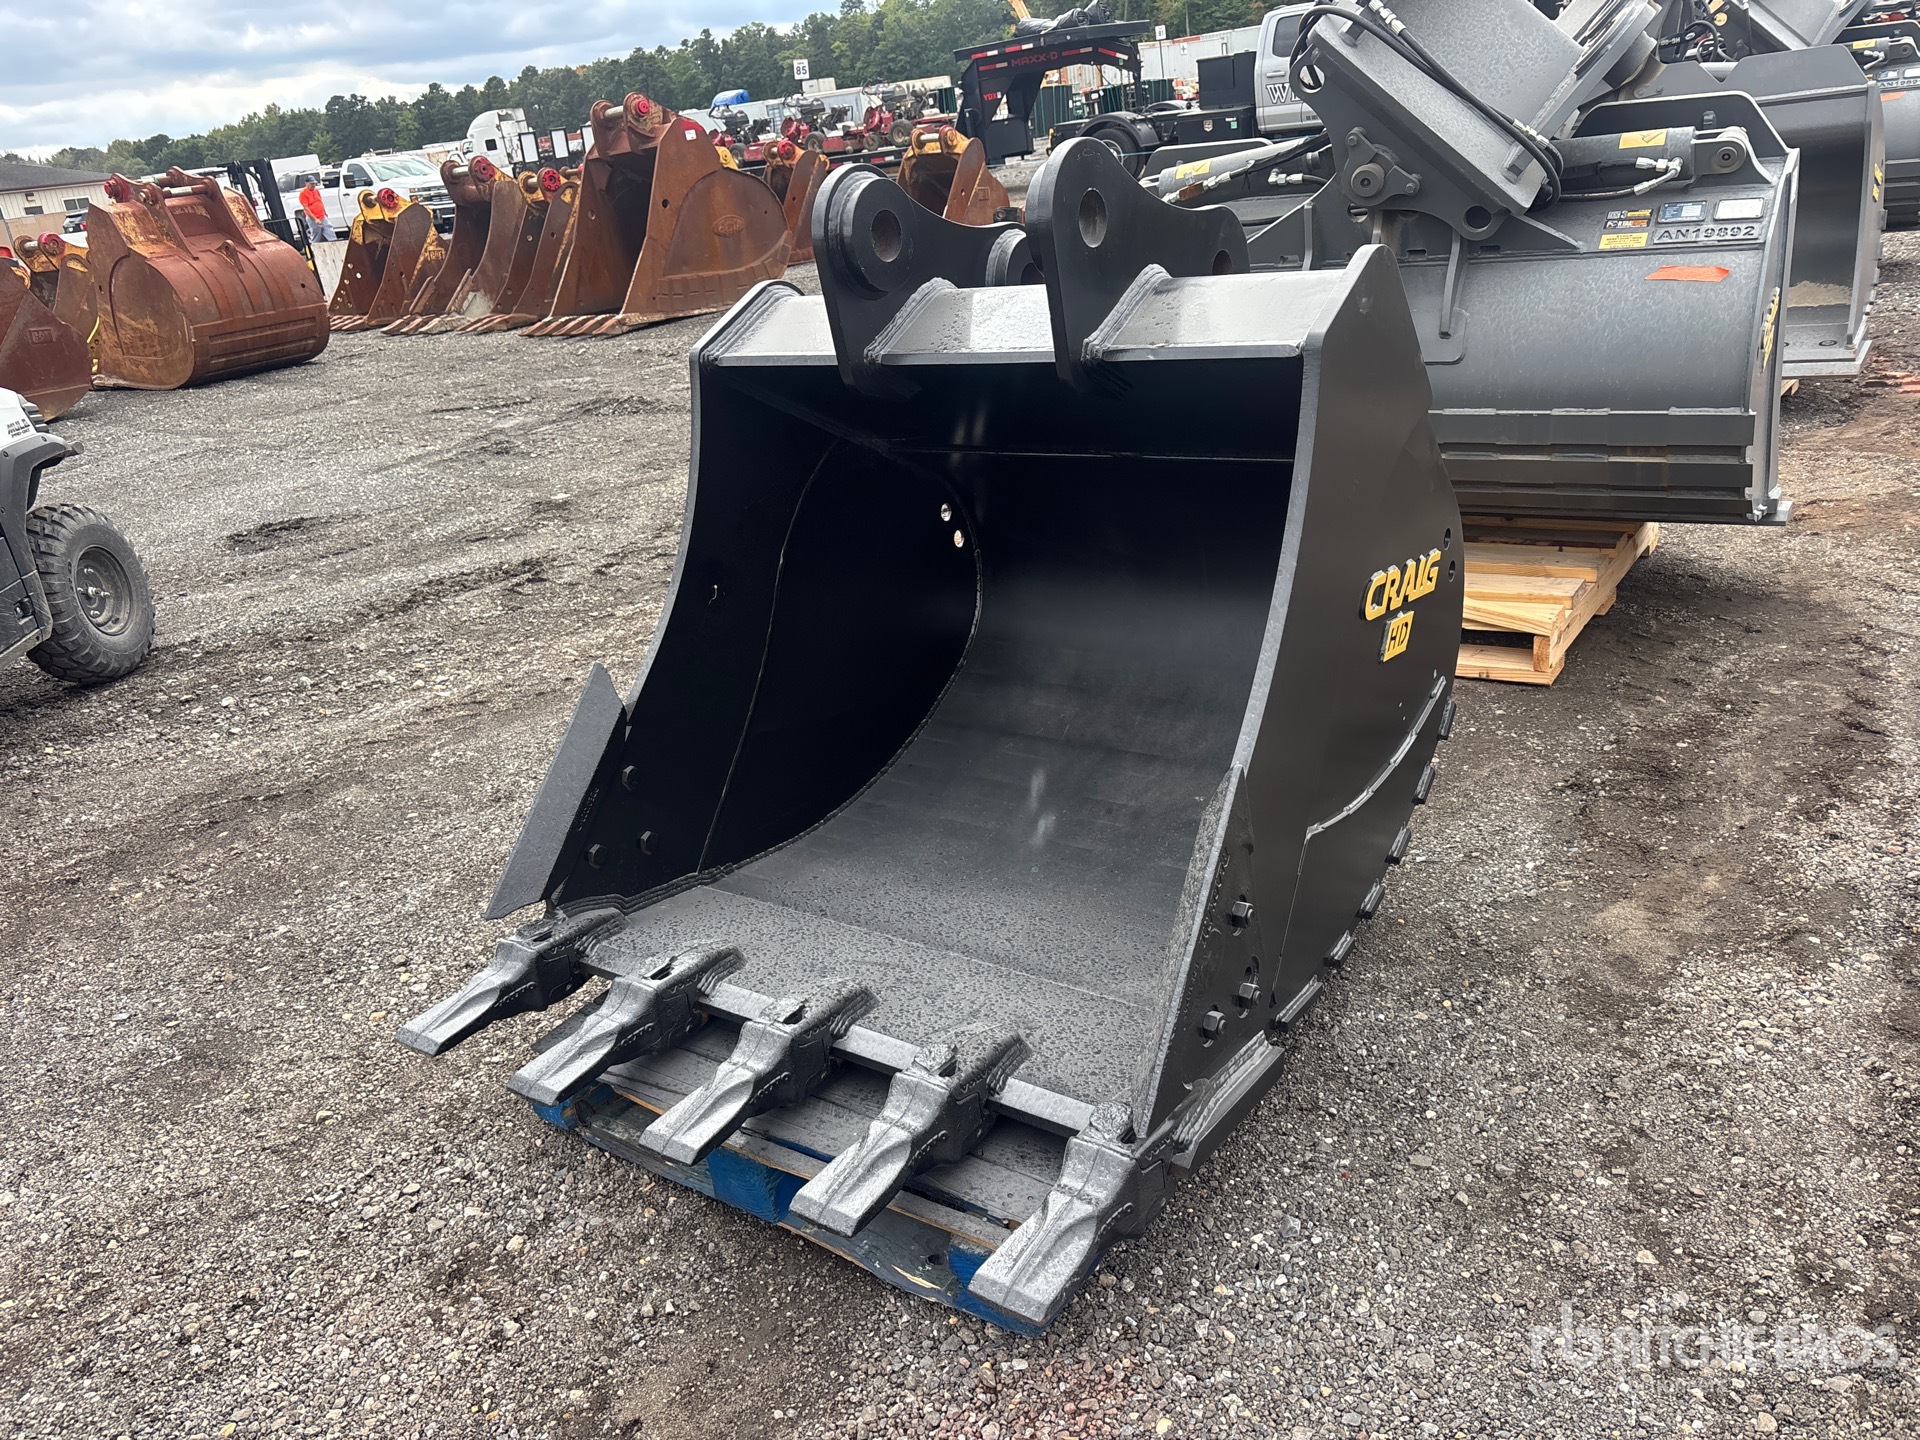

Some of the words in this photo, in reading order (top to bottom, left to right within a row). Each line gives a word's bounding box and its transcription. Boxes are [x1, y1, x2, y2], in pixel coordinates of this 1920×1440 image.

[796, 66, 808, 75] 85
[1656, 226, 1756, 241] AN19892
[1364, 548, 1441, 621] CRAIG
[1386, 619, 1410, 654] HD
